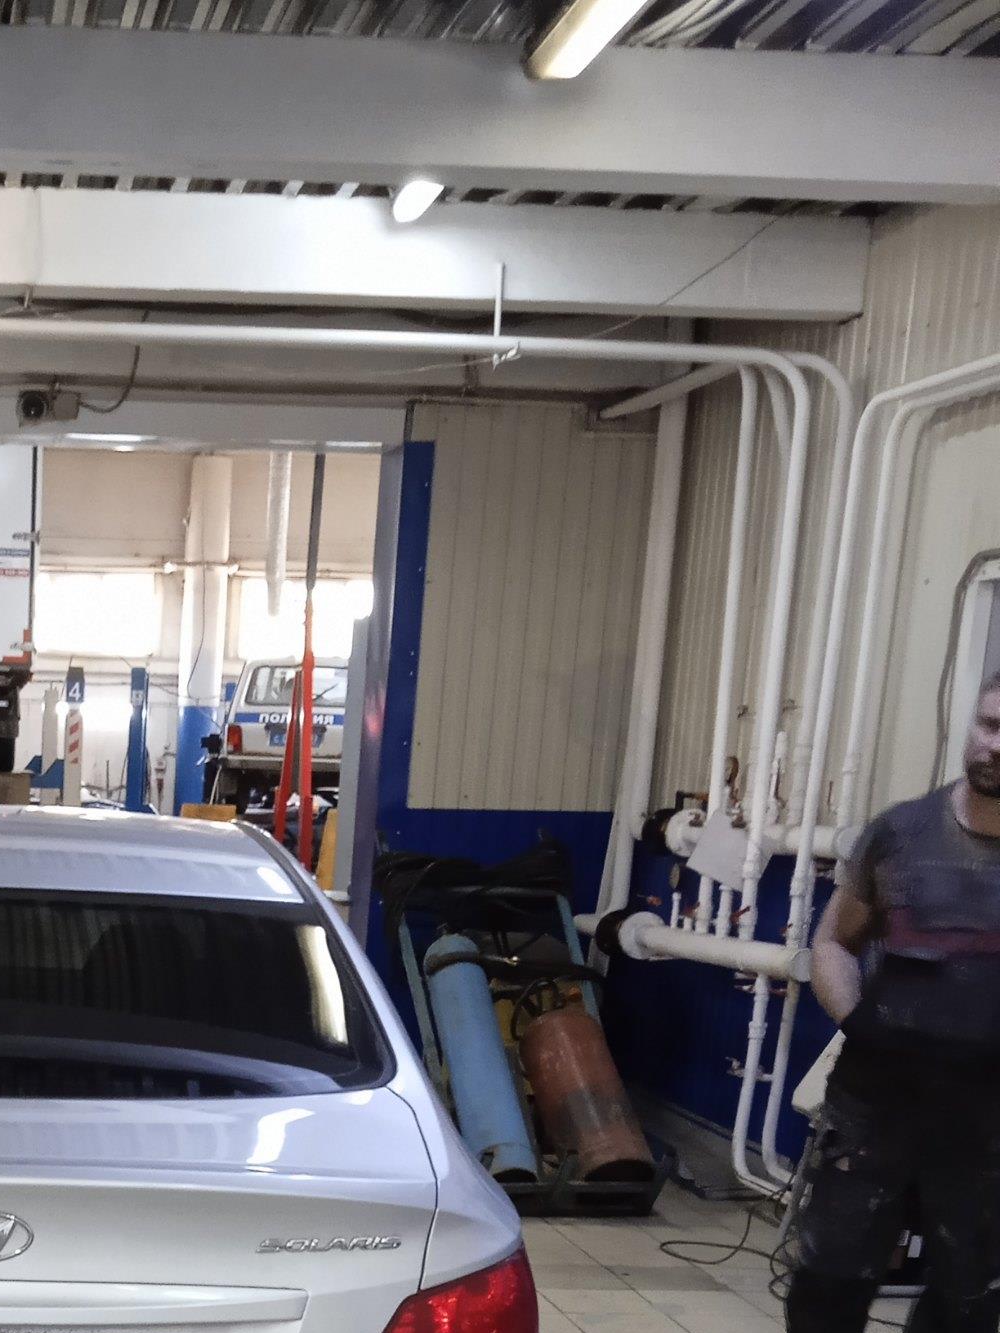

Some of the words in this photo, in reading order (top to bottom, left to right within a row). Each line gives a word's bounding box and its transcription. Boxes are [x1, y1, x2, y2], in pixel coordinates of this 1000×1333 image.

[69, 681, 82, 701] 4
[258, 711, 335, 725] ПОЛИЯ
[255, 1236, 402, 1253] SOLARIS
